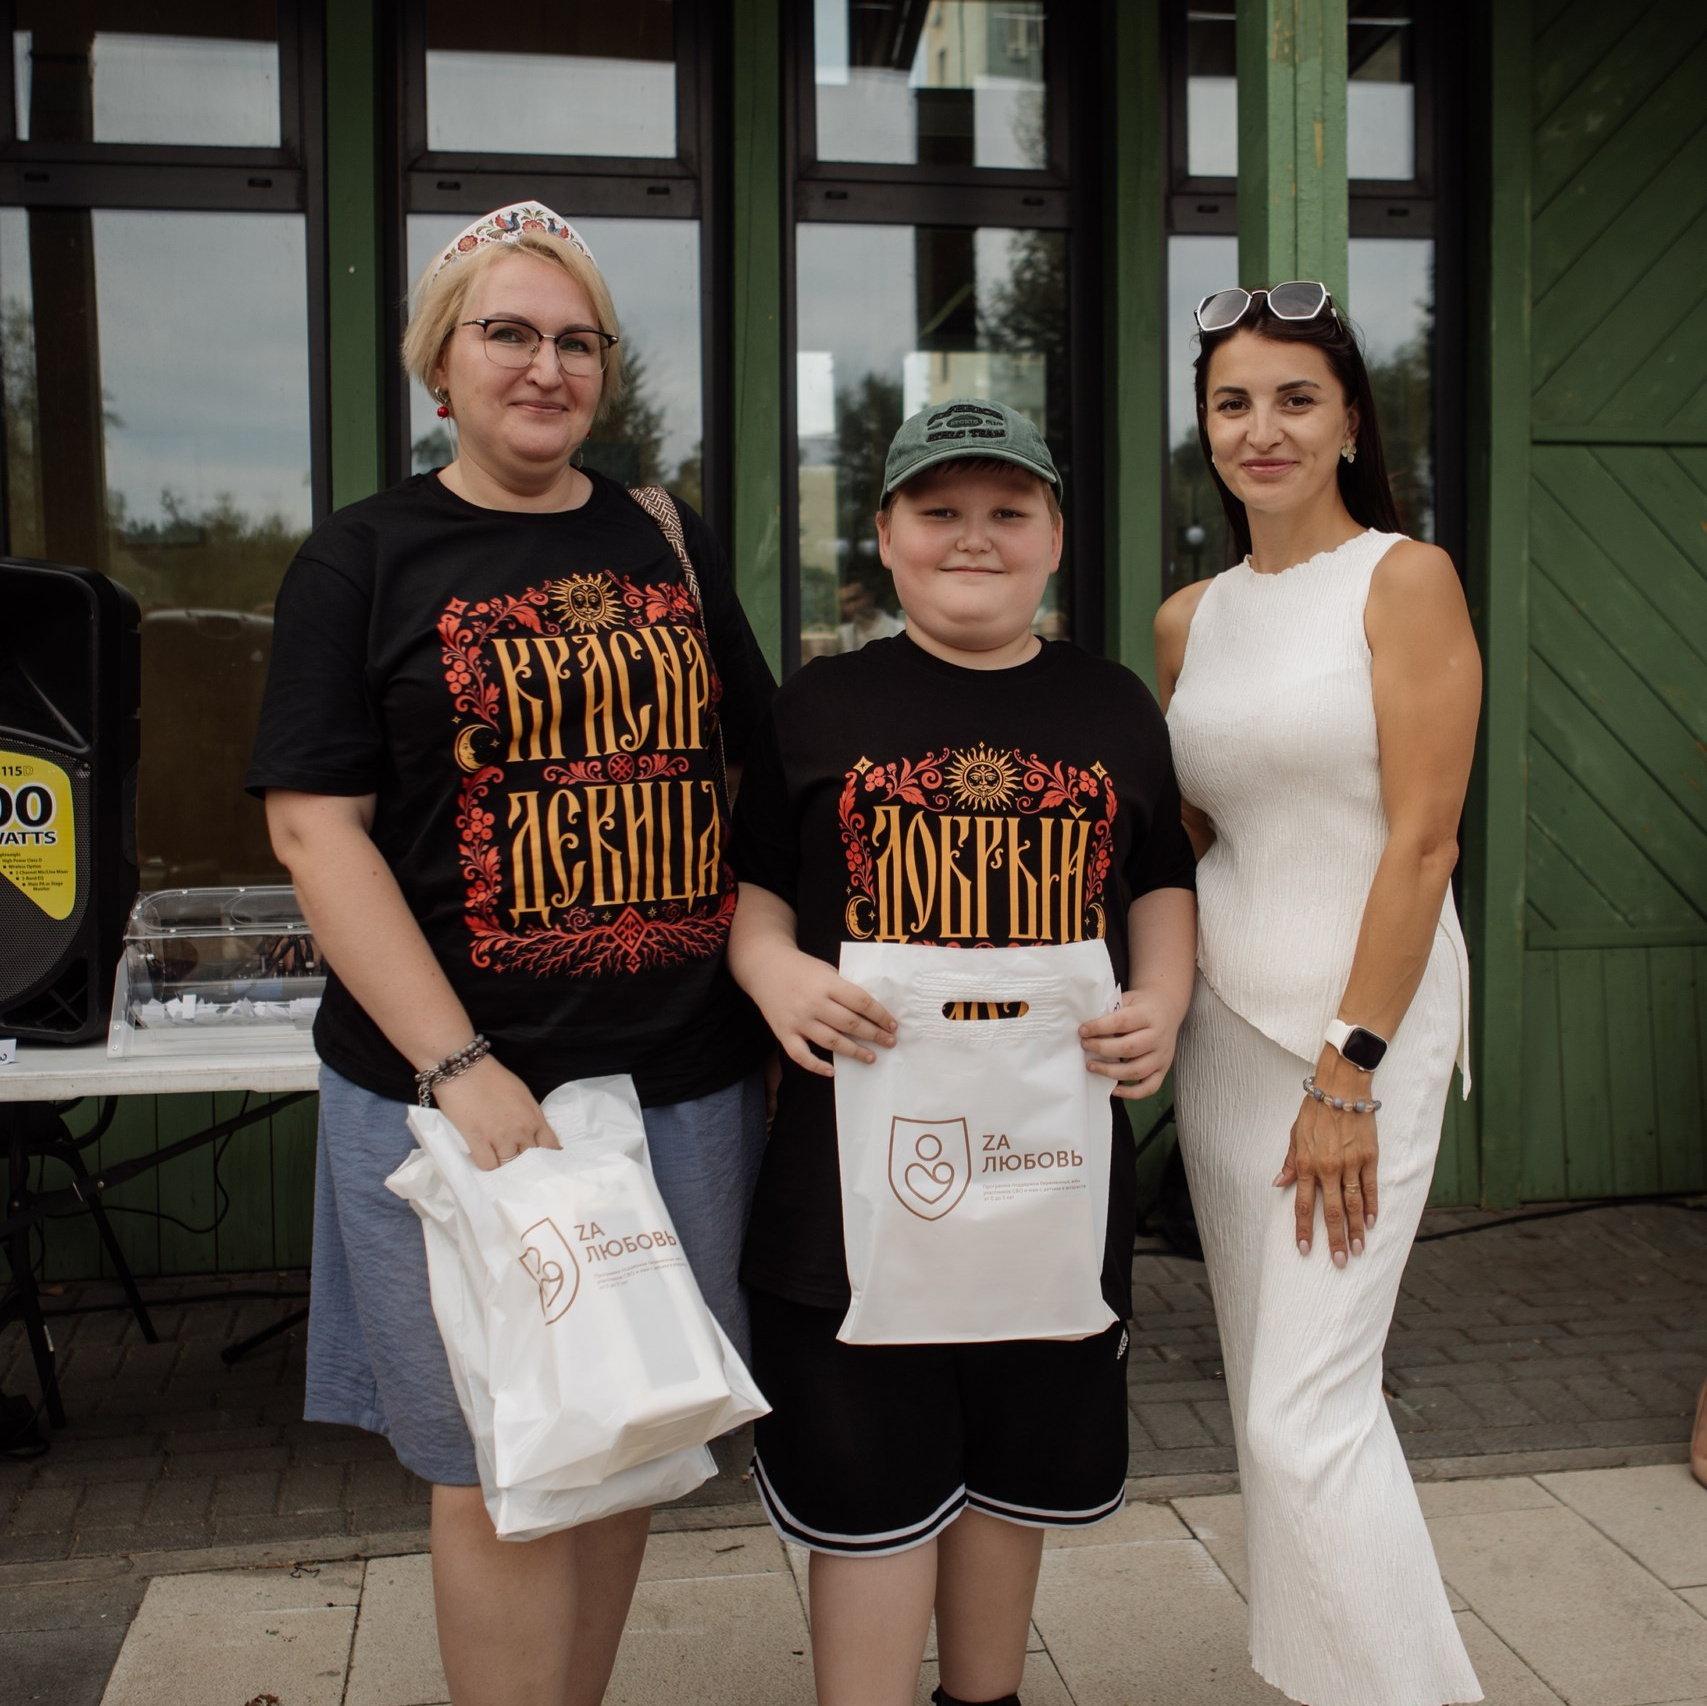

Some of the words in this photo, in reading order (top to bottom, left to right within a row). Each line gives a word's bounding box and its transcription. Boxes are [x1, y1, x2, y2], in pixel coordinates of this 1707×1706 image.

[492, 625, 711, 762] КРАСНА
[507, 780, 720, 929] ДЕВИЦА
[871, 805, 1092, 944] ДОБРЫЙ
[982, 1134, 1011, 1151] ZA
[982, 1150, 1083, 1173] ЛЮБОВЬ
[573, 1221, 606, 1241] ZA
[585, 1230, 677, 1263] ЛЮБОВЬ
